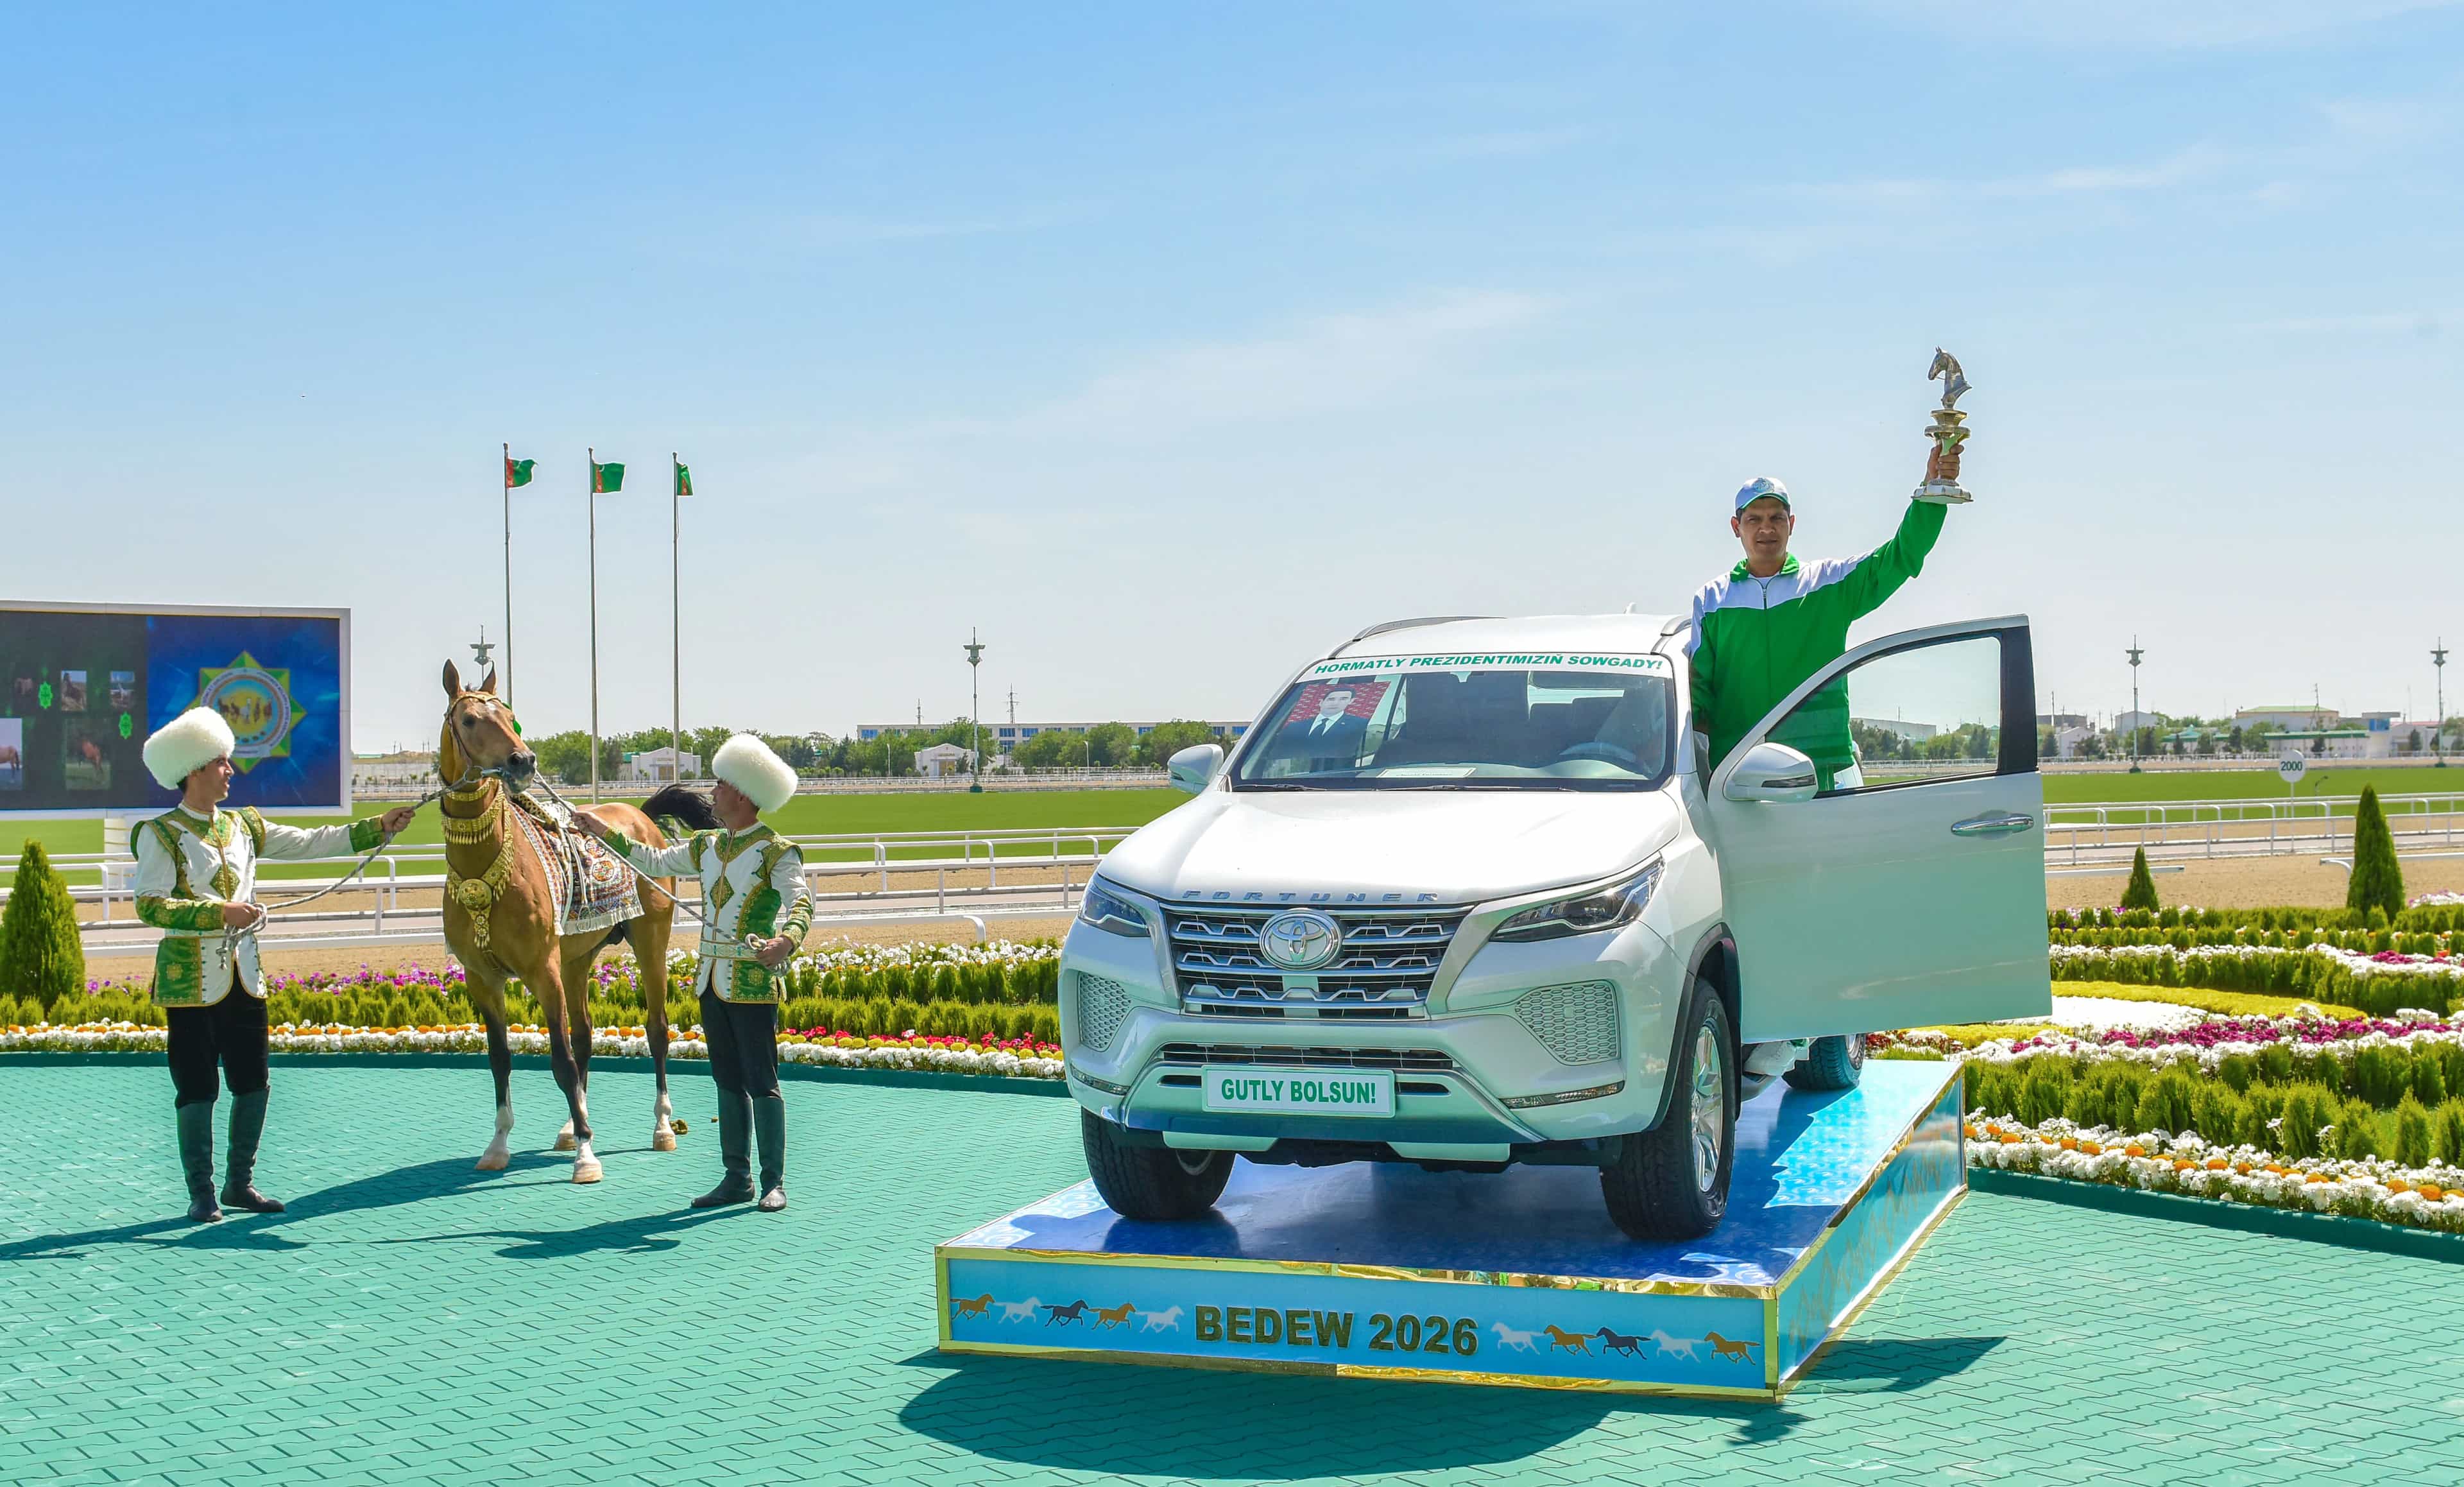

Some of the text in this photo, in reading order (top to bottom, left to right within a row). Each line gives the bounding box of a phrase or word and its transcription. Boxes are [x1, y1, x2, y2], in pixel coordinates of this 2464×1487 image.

[1315, 658, 1406, 674] HORMATLY
[1568, 657, 1663, 669] SOWGADY!
[2280, 761, 2303, 771] 2000
[1182, 890, 1439, 901] FORTUNER
[1221, 1078, 1376, 1104] GUTLY BOLSUN!
[1195, 1305, 1478, 1356] BEDEW 2026
